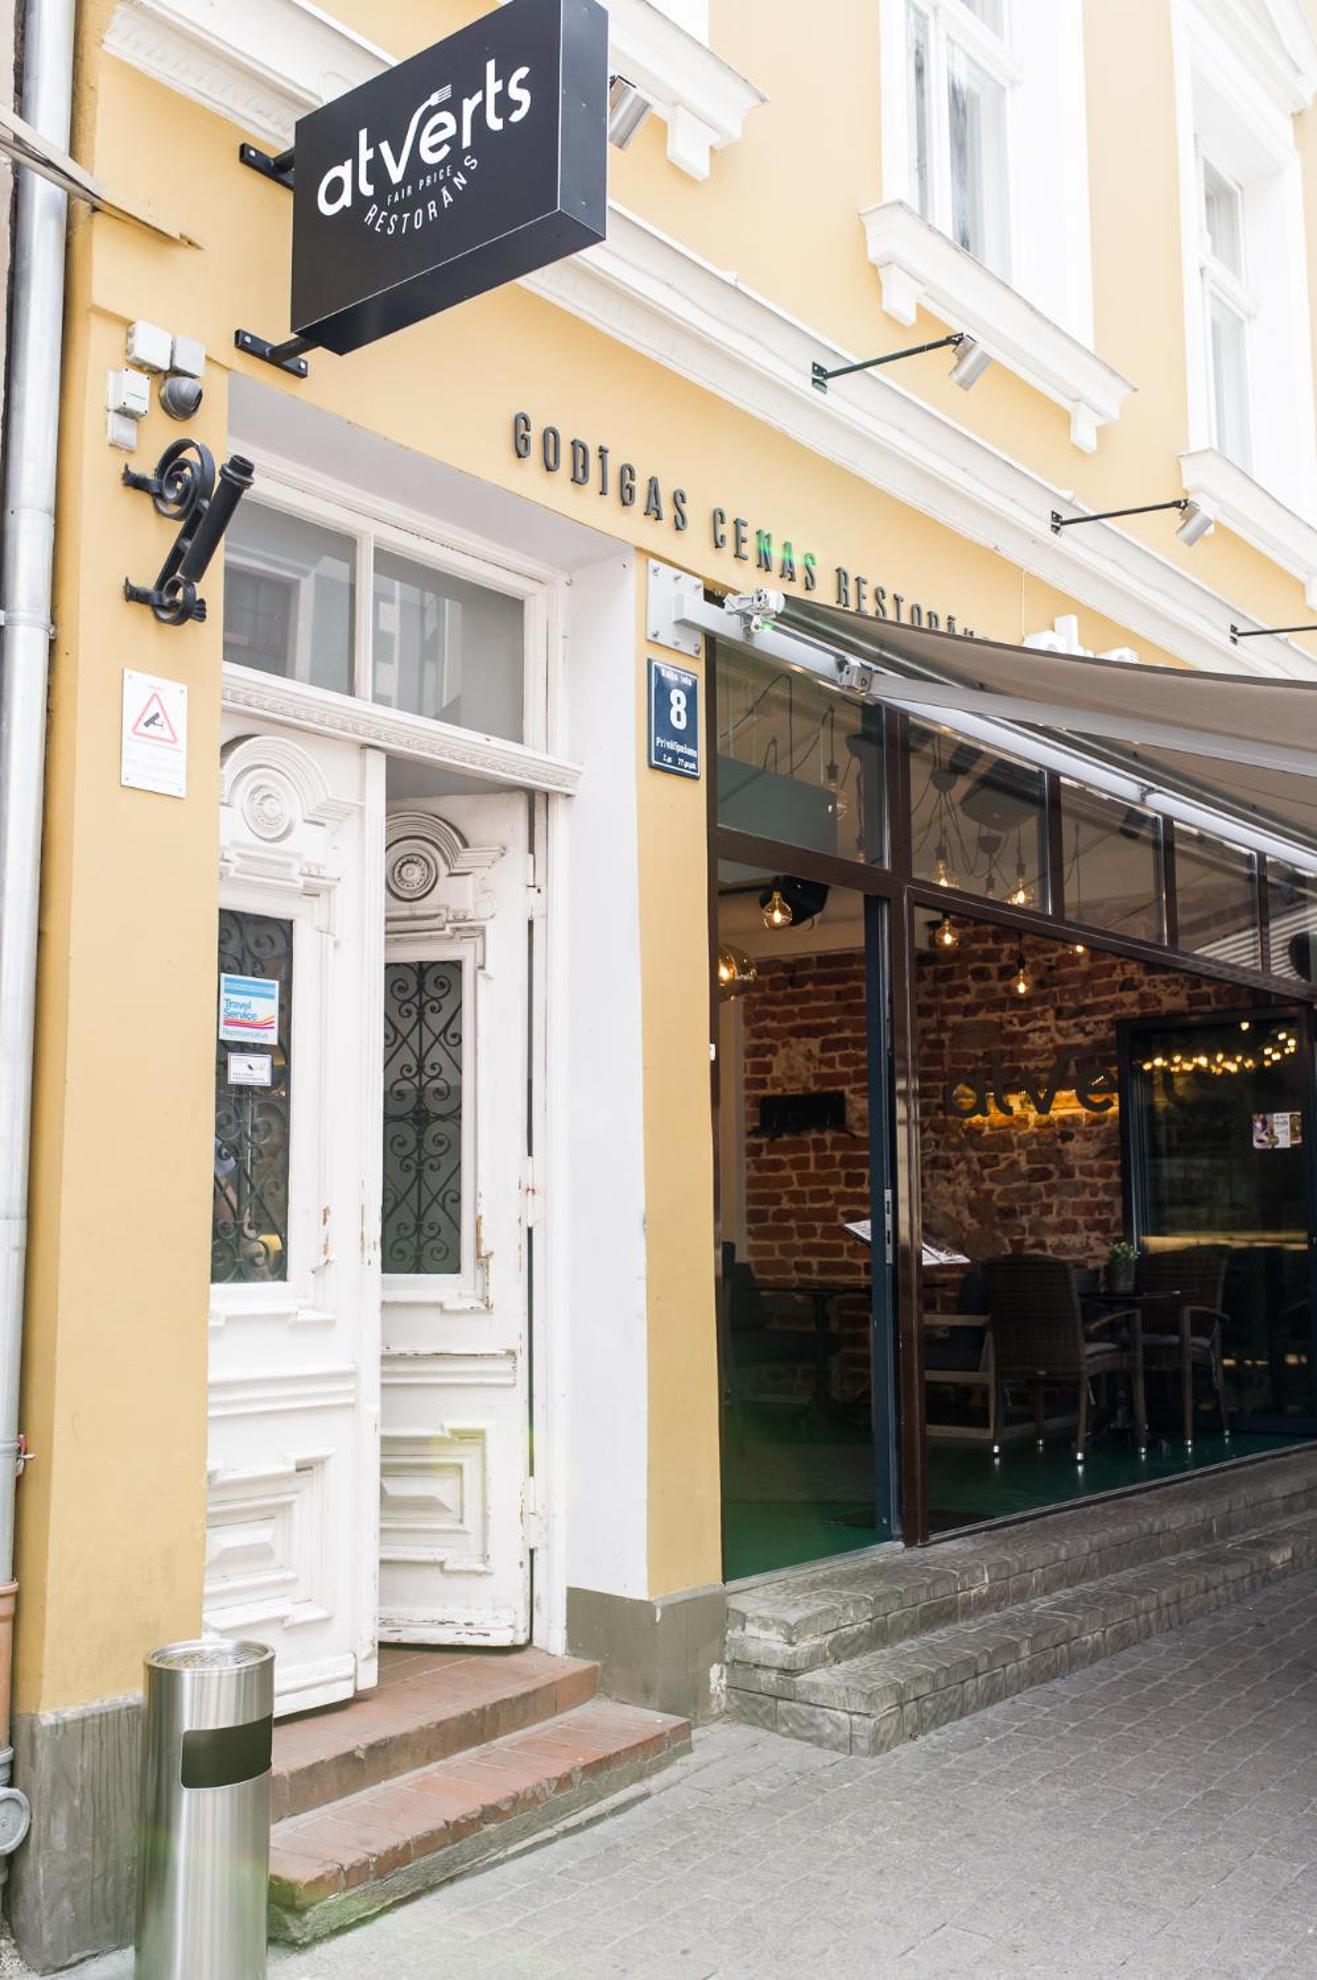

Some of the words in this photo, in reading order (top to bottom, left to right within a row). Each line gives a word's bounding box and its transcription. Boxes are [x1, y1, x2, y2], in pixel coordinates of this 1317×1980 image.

[317, 58, 532, 216] atverts
[364, 155, 479, 235] RESTORĀNS
[386, 184, 413, 207] FAIR
[418, 164, 453, 191] PRICE
[514, 411, 688, 532] GODĪGAS
[712, 507, 818, 592] CENAS
[670, 689, 687, 730] 8
[224, 1009, 257, 1021] Service
[225, 998, 252, 1011] Travel
